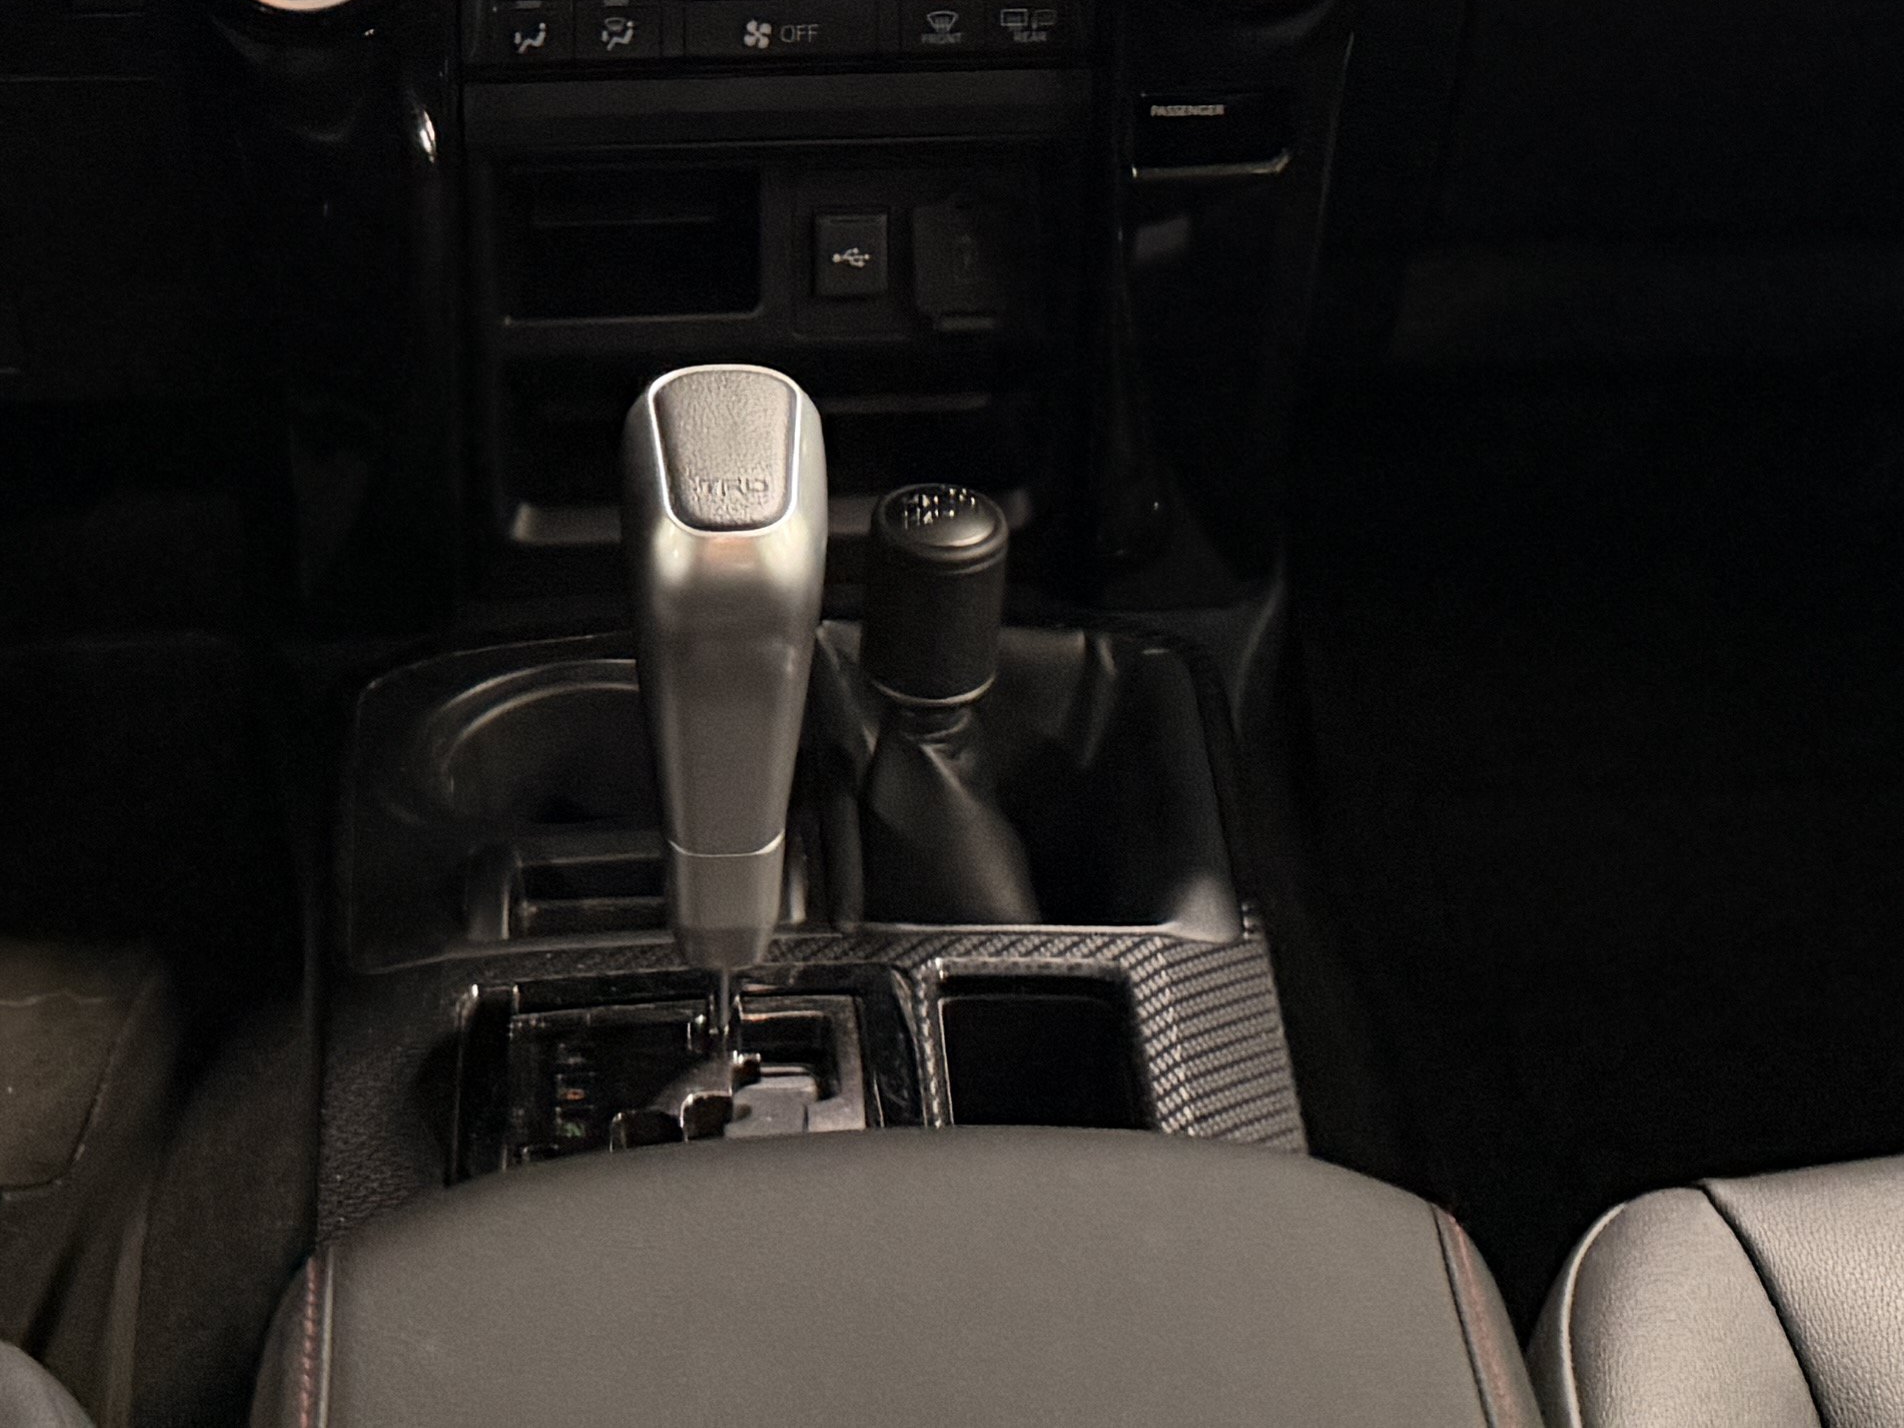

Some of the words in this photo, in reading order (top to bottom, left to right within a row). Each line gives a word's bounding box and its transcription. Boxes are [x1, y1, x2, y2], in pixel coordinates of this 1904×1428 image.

[779, 23, 819, 43] OFF
[1149, 104, 1225, 118] PASSENGER
[698, 477, 770, 497] TRD
